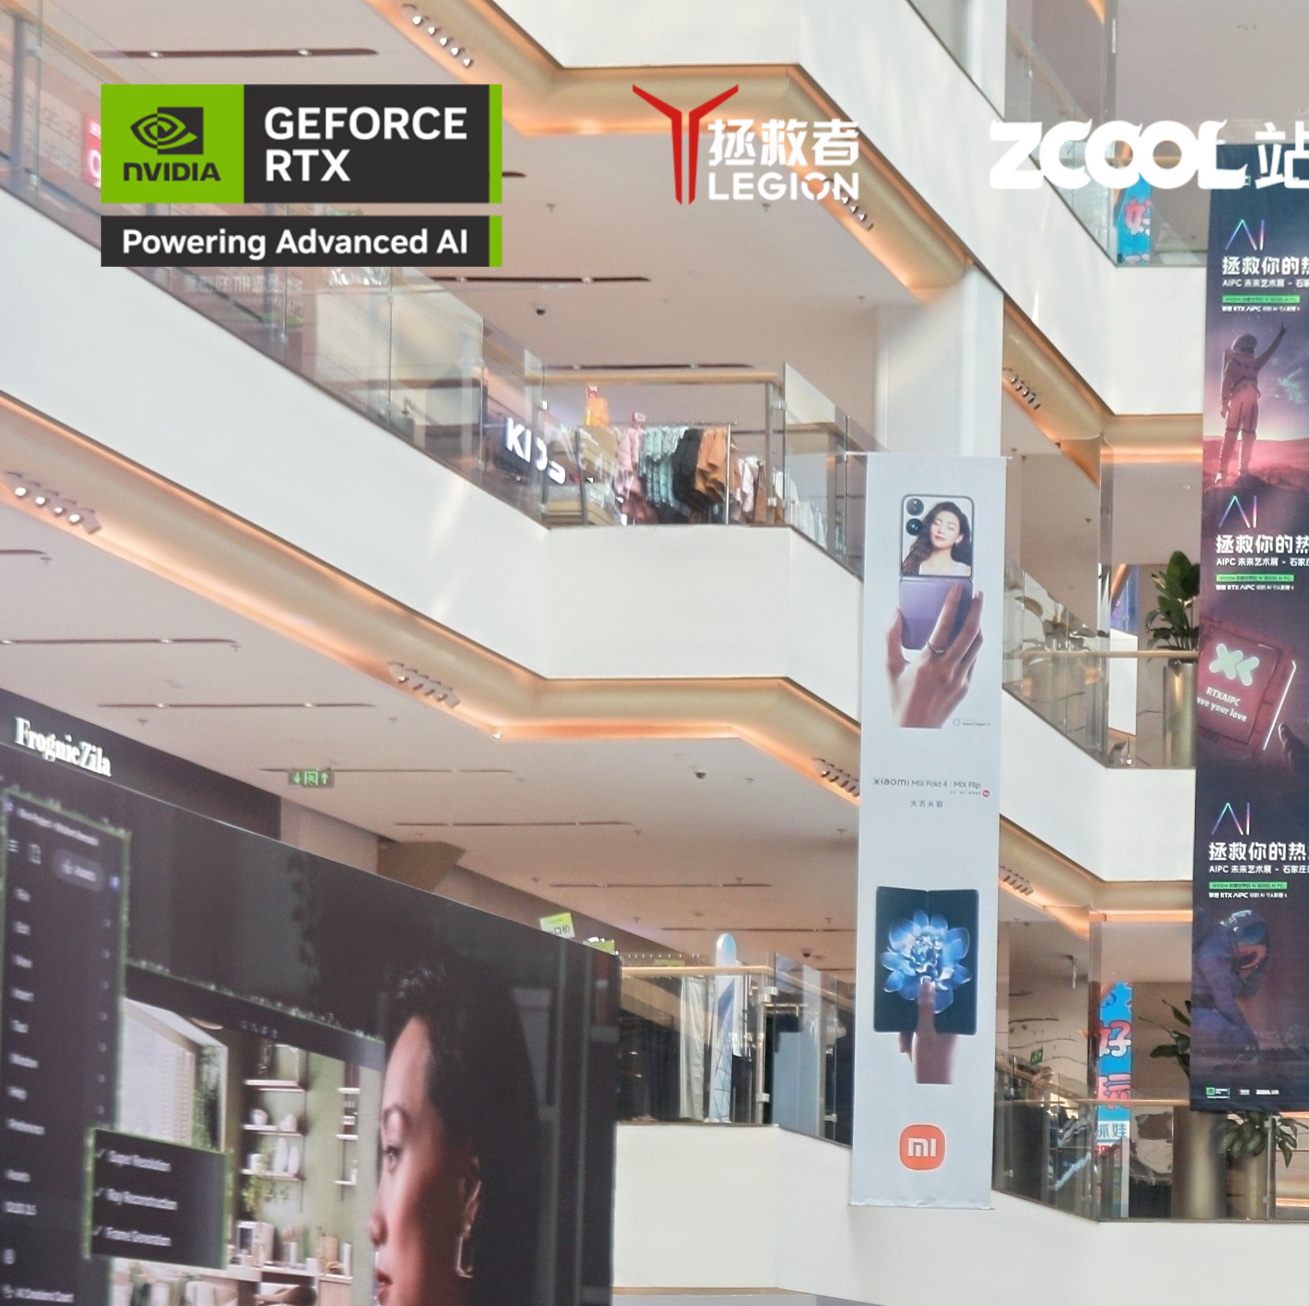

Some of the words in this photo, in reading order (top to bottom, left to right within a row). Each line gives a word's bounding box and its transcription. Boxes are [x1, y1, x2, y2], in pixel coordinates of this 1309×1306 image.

[1211, 702, 1234, 717] your
[1229, 708, 1248, 722] love
[15, 717, 112, 778] FrognieZila
